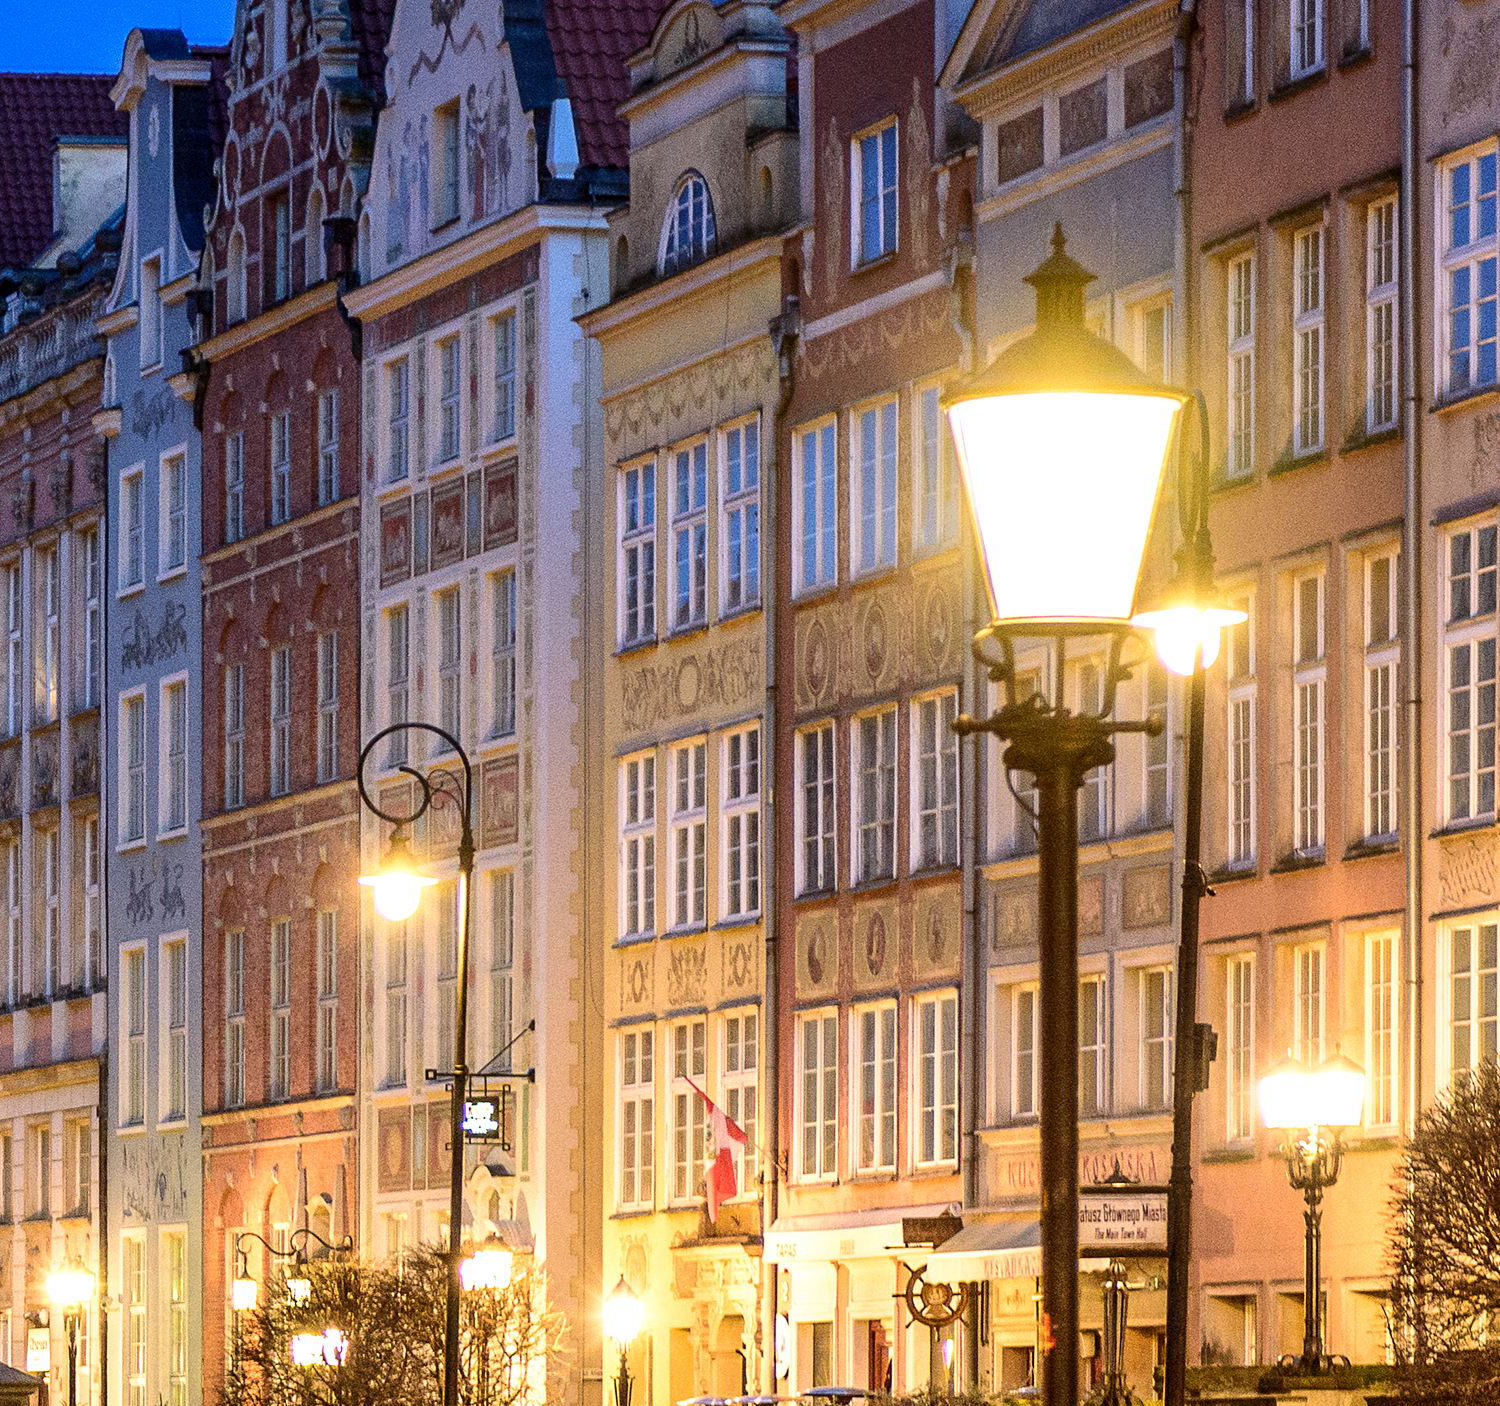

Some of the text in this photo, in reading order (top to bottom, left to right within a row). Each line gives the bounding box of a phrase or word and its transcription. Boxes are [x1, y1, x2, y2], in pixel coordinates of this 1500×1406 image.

[1079, 1202, 1167, 1225] atusz Głównego Miasta
[1095, 1226, 1147, 1239] The Main Town Hall
[776, 1243, 797, 1258] TAPAS
